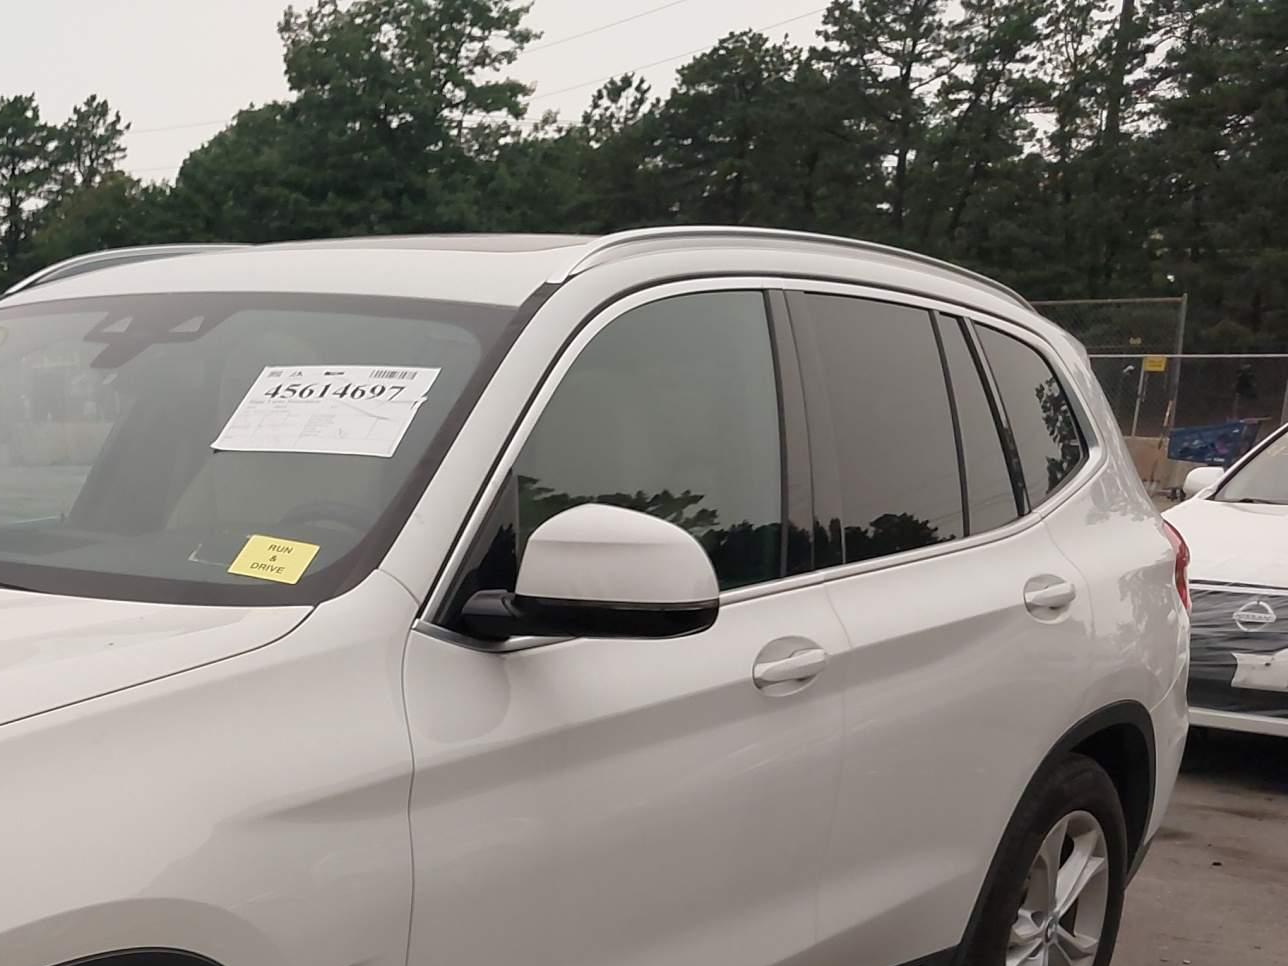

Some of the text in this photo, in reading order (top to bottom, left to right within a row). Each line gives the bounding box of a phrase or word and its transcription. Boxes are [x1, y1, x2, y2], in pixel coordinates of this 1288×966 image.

[264, 383, 406, 401] 45614697
[267, 544, 293, 554] RUN
[249, 562, 286, 574] DRIVE
